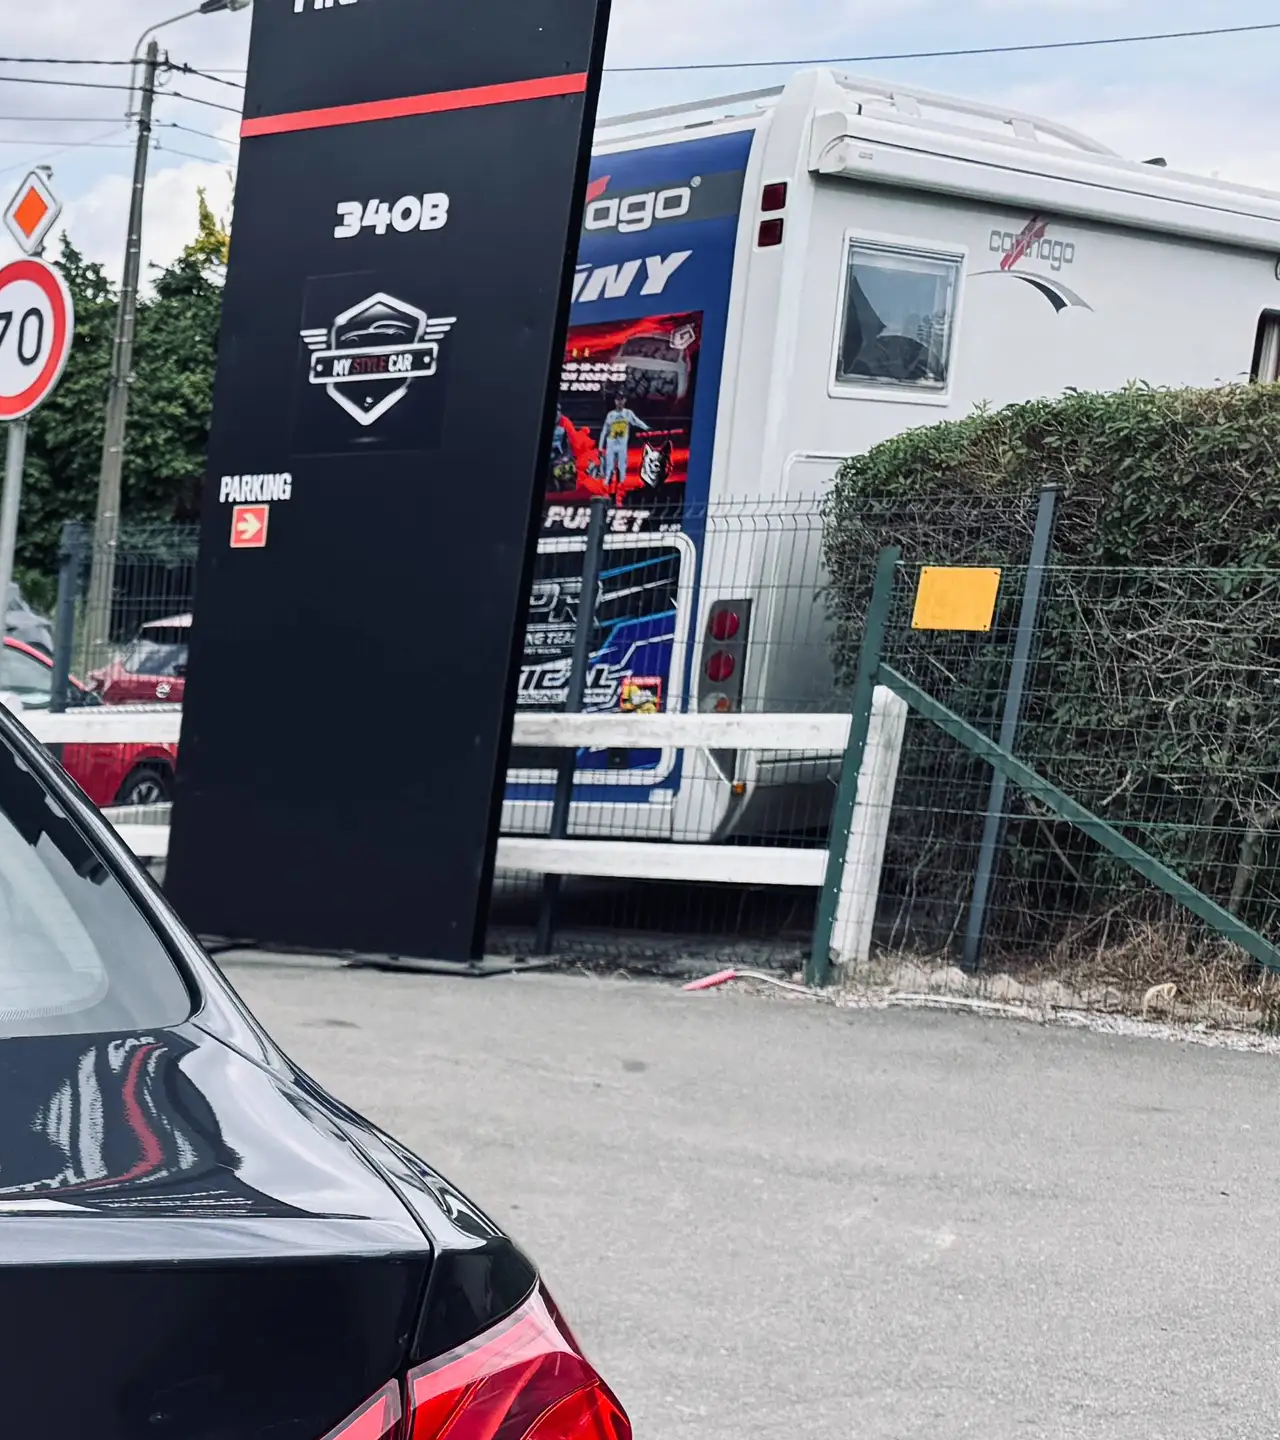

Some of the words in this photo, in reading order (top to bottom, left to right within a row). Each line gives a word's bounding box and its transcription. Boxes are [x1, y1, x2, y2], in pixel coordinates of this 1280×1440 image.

[333, 192, 450, 239] 340B
[332, 358, 352, 377] MY
[352, 356, 387, 373] STYLE
[388, 353, 413, 372] CAR
[219, 472, 292, 503] PARKING
